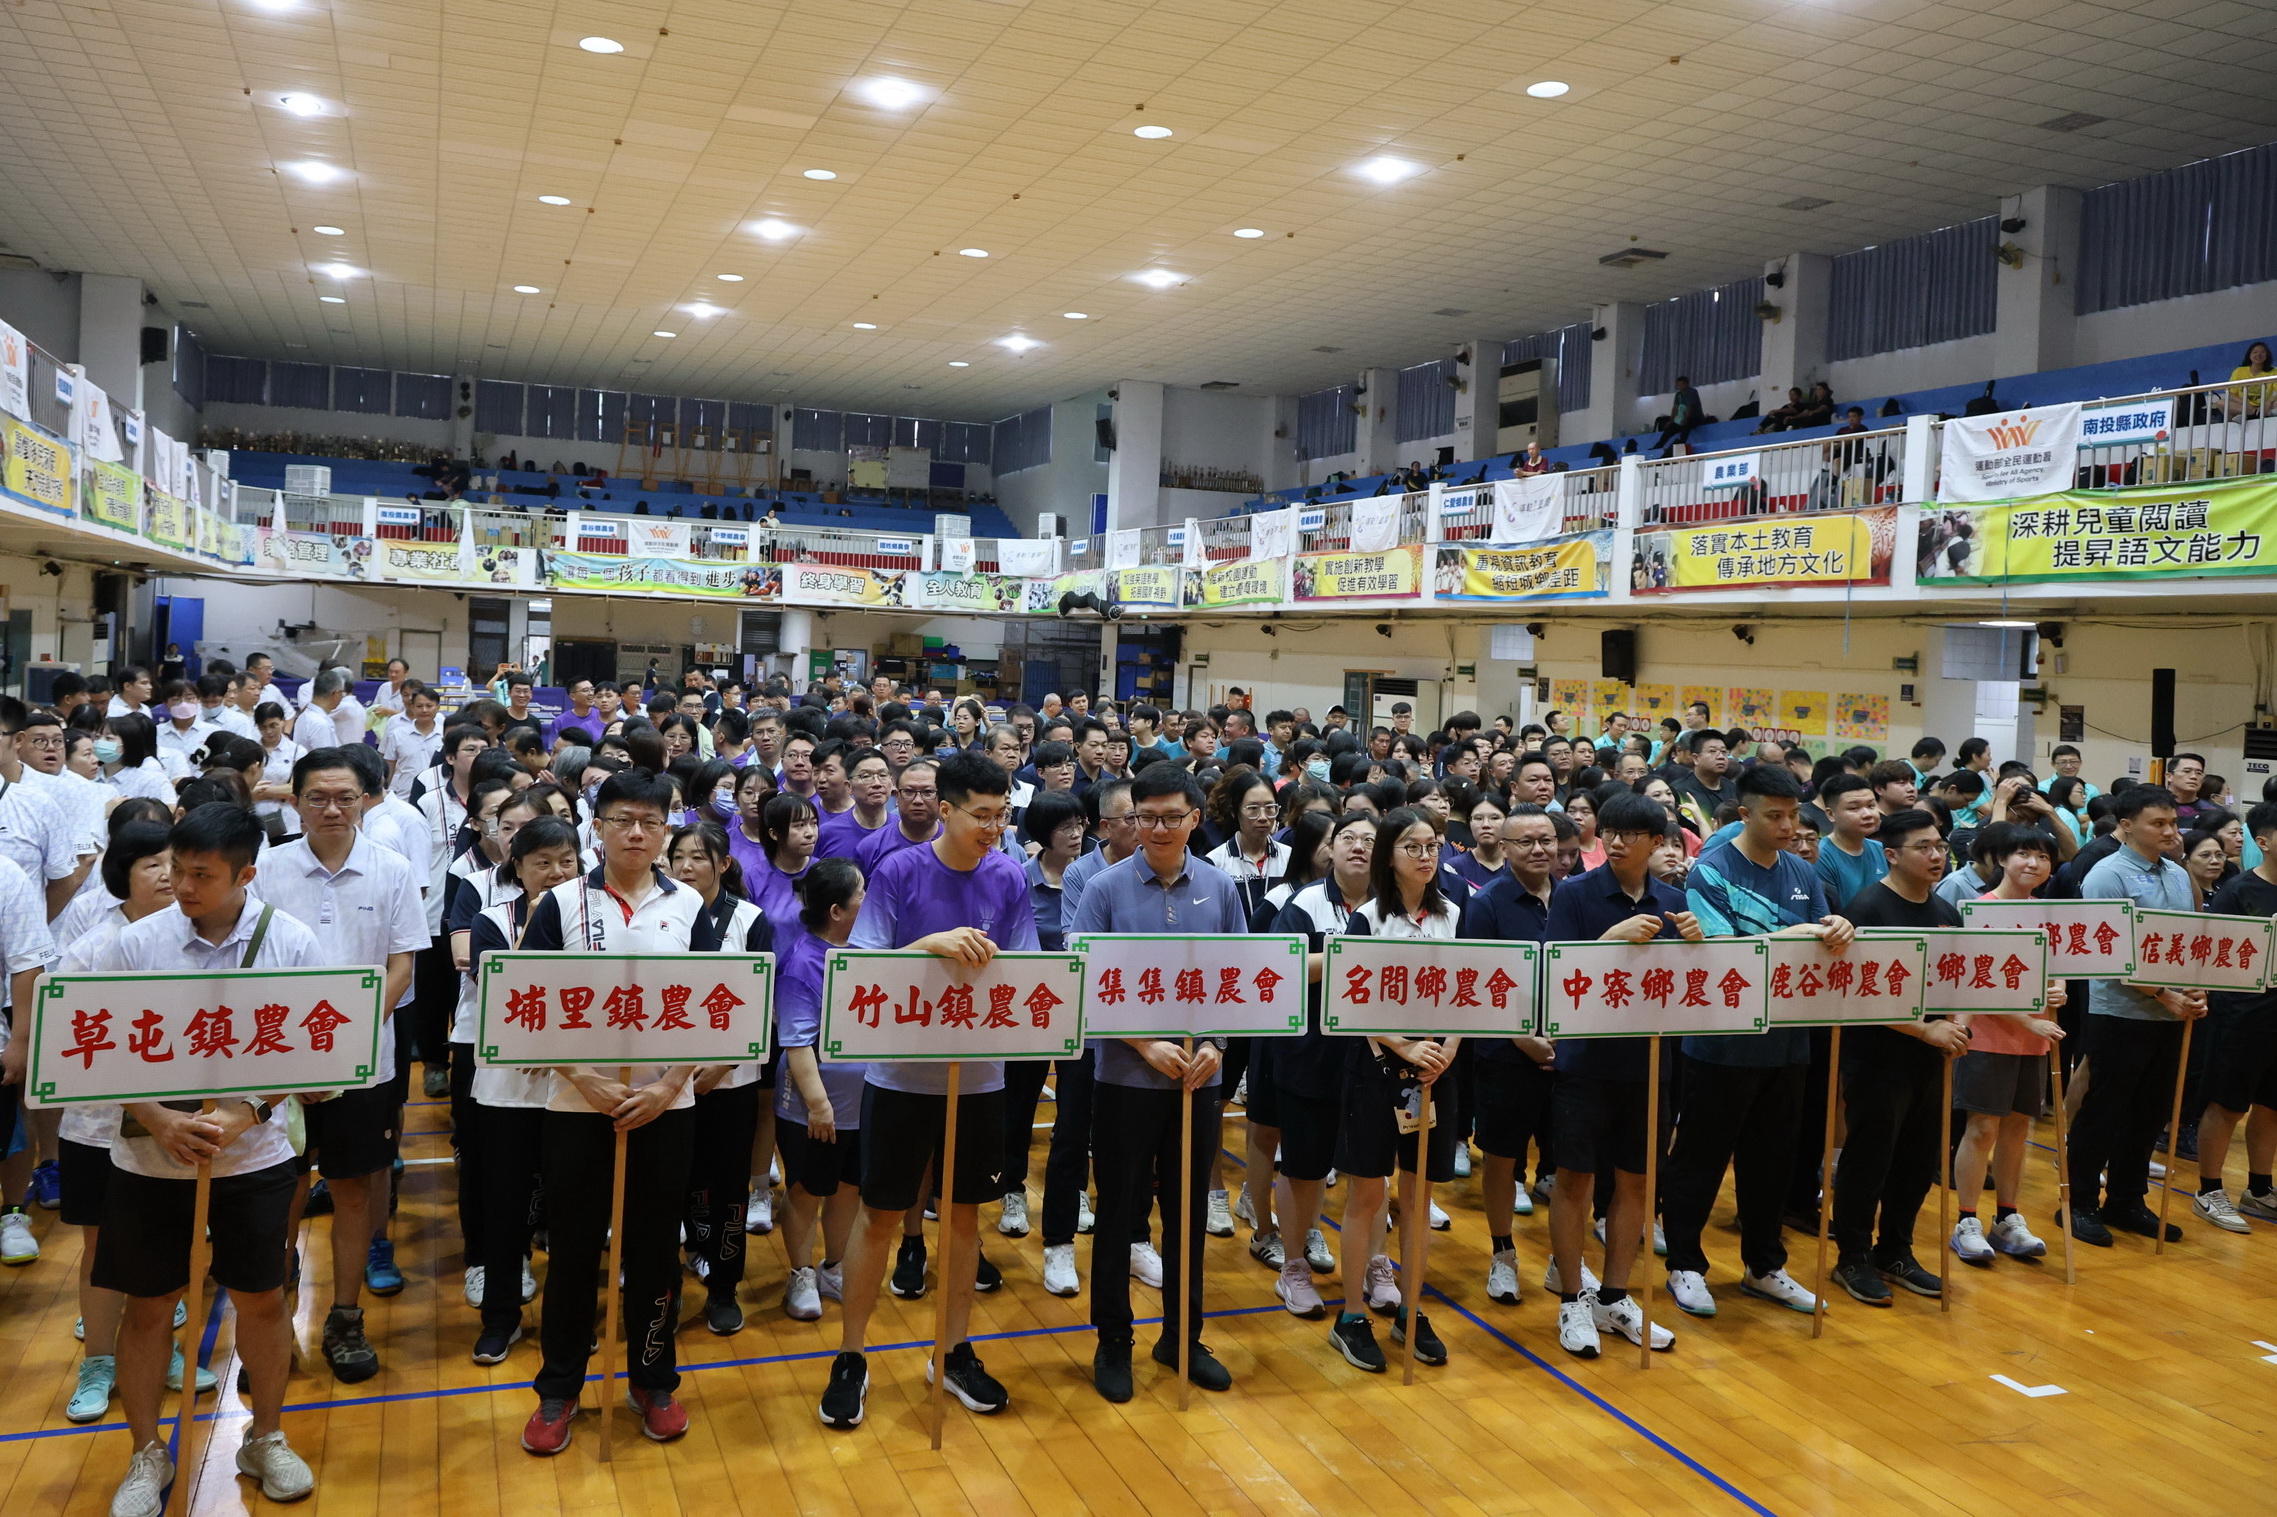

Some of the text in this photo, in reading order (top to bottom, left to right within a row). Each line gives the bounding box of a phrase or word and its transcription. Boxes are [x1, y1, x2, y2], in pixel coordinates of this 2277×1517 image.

[2083, 410, 2167, 437] 南投縣政府
[1714, 462, 1749, 480] 農業部
[1975, 451, 2052, 471] 運動部全民運動署
[2010, 468, 2019, 476] All
[2016, 475, 2039, 484] Sports
[1443, 495, 1474, 509] 仁愛鄉農會
[2011, 500, 2210, 540] 深耕兒童閱讀
[1690, 526, 1814, 557] 落實本土教育
[2053, 530, 2261, 568] 提昇語文能力
[1324, 557, 1385, 576] 實施創新教學
[1475, 551, 1560, 572] 重視資訊教育
[1717, 550, 1843, 580] 傳承地方文化
[800, 571, 866, 595] 終身學習
[926, 580, 984, 599] 全人教育
[1337, 574, 1398, 592] 促進有效學習
[1491, 567, 1580, 592] 縮短城鄉差距
[592, 918, 607, 951] FILA
[2139, 931, 2259, 971] 信義鄉農會
[1098, 966, 1285, 1006] 集集鎮農會
[1340, 964, 1519, 1010] 名間鄉農會
[1769, 957, 1913, 999] 鹿谷鄉農會
[1927, 952, 2031, 991] 鄉農會
[1562, 967, 1752, 1011] 中寮鄉農會
[503, 983, 747, 1033] 埔里鎮農會
[848, 982, 1065, 1031] 竹山鎮農會
[61, 999, 353, 1071] 草屯鎮農會
[691, 1187, 712, 1242] FILA
[719, 1203, 747, 1261] FILA
[642, 1288, 671, 1366] FILA
